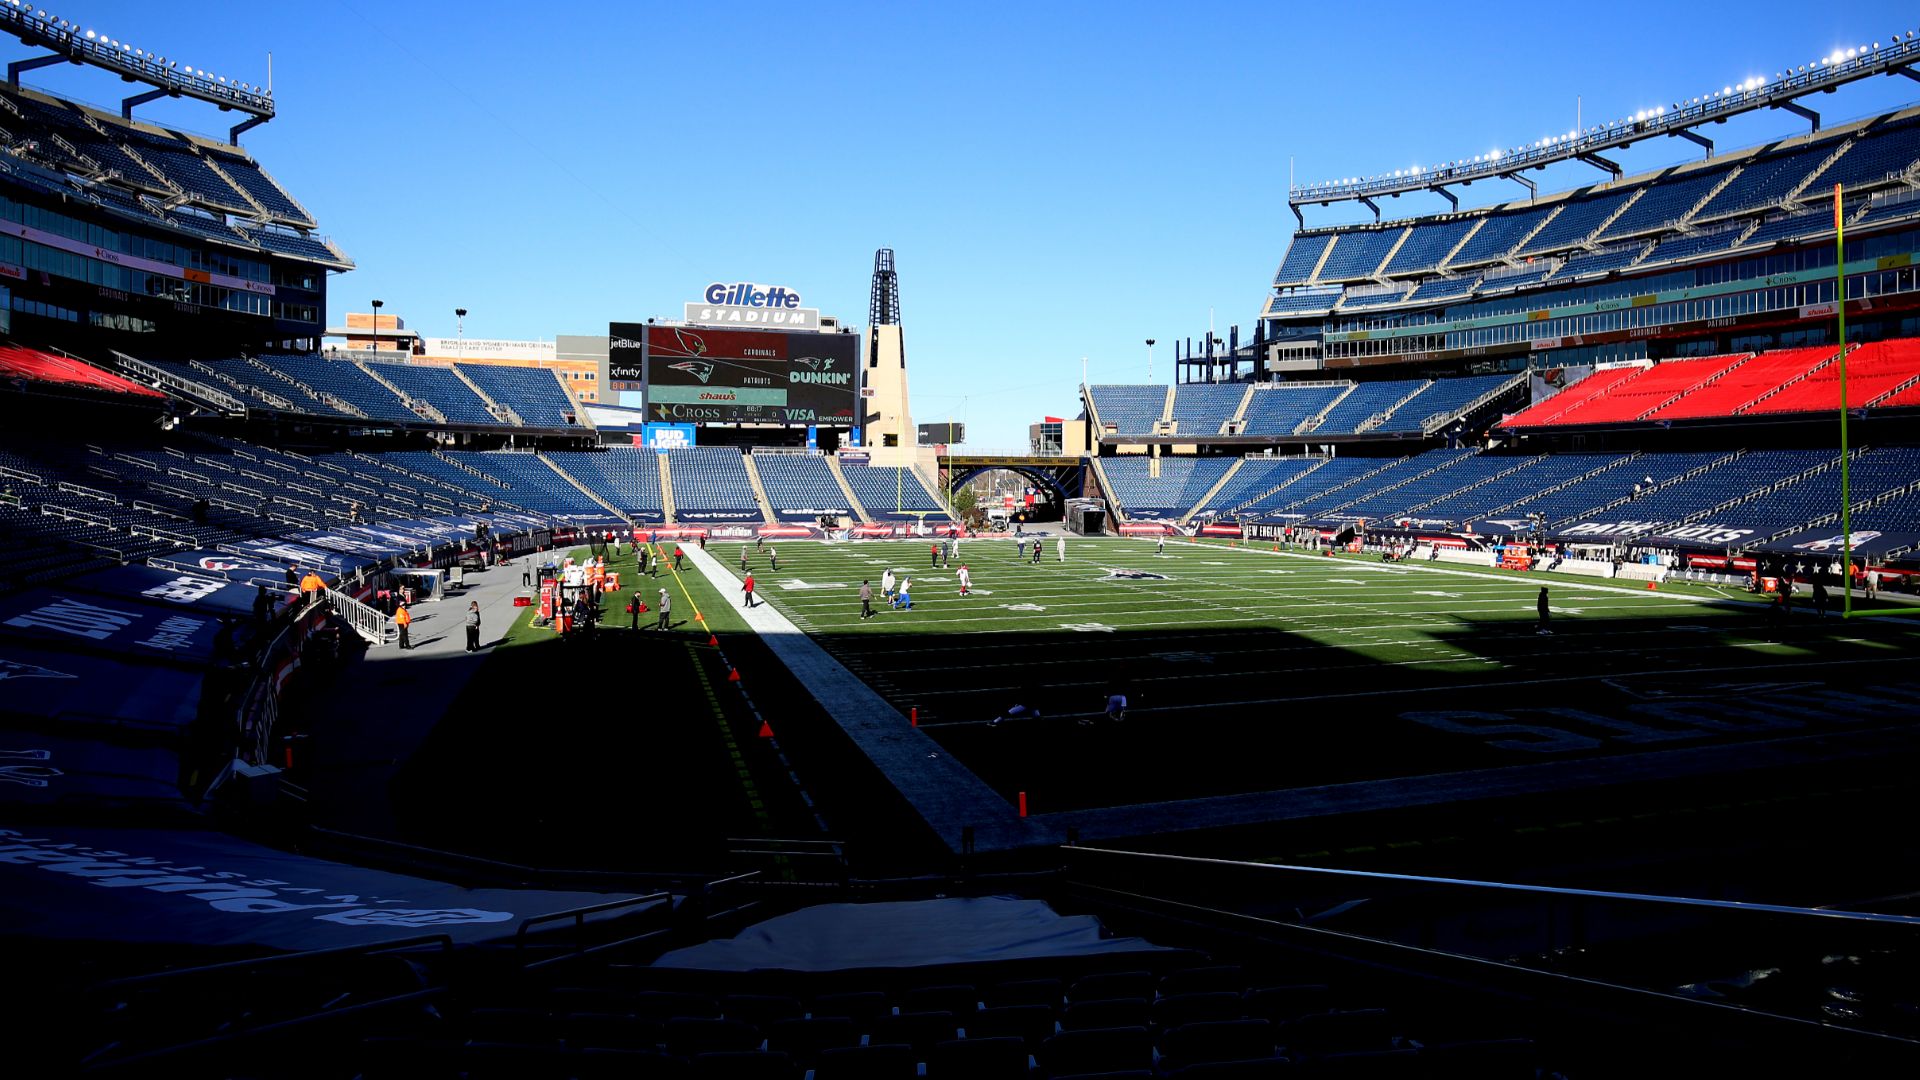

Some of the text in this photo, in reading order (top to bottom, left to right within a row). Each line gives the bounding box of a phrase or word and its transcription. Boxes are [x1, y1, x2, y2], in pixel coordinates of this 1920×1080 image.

[706, 284, 800, 308] Gillette
[700, 308, 805, 324] STADIUM
[1707, 317, 1737, 328] PATRIOTS
[1630, 326, 1661, 338] CARDINALS
[610, 339, 641, 349] jetBlue
[744, 349, 776, 357] CARDINALS
[611, 367, 640, 377] xfinity
[789, 371, 851, 384] DUNKIN'
[744, 377, 771, 385] PATRIOTS
[783, 408, 816, 421] VISA
[818, 415, 853, 423] EMPOWER
[655, 429, 684, 440] BUD
[650, 438, 689, 448] LIGHT
